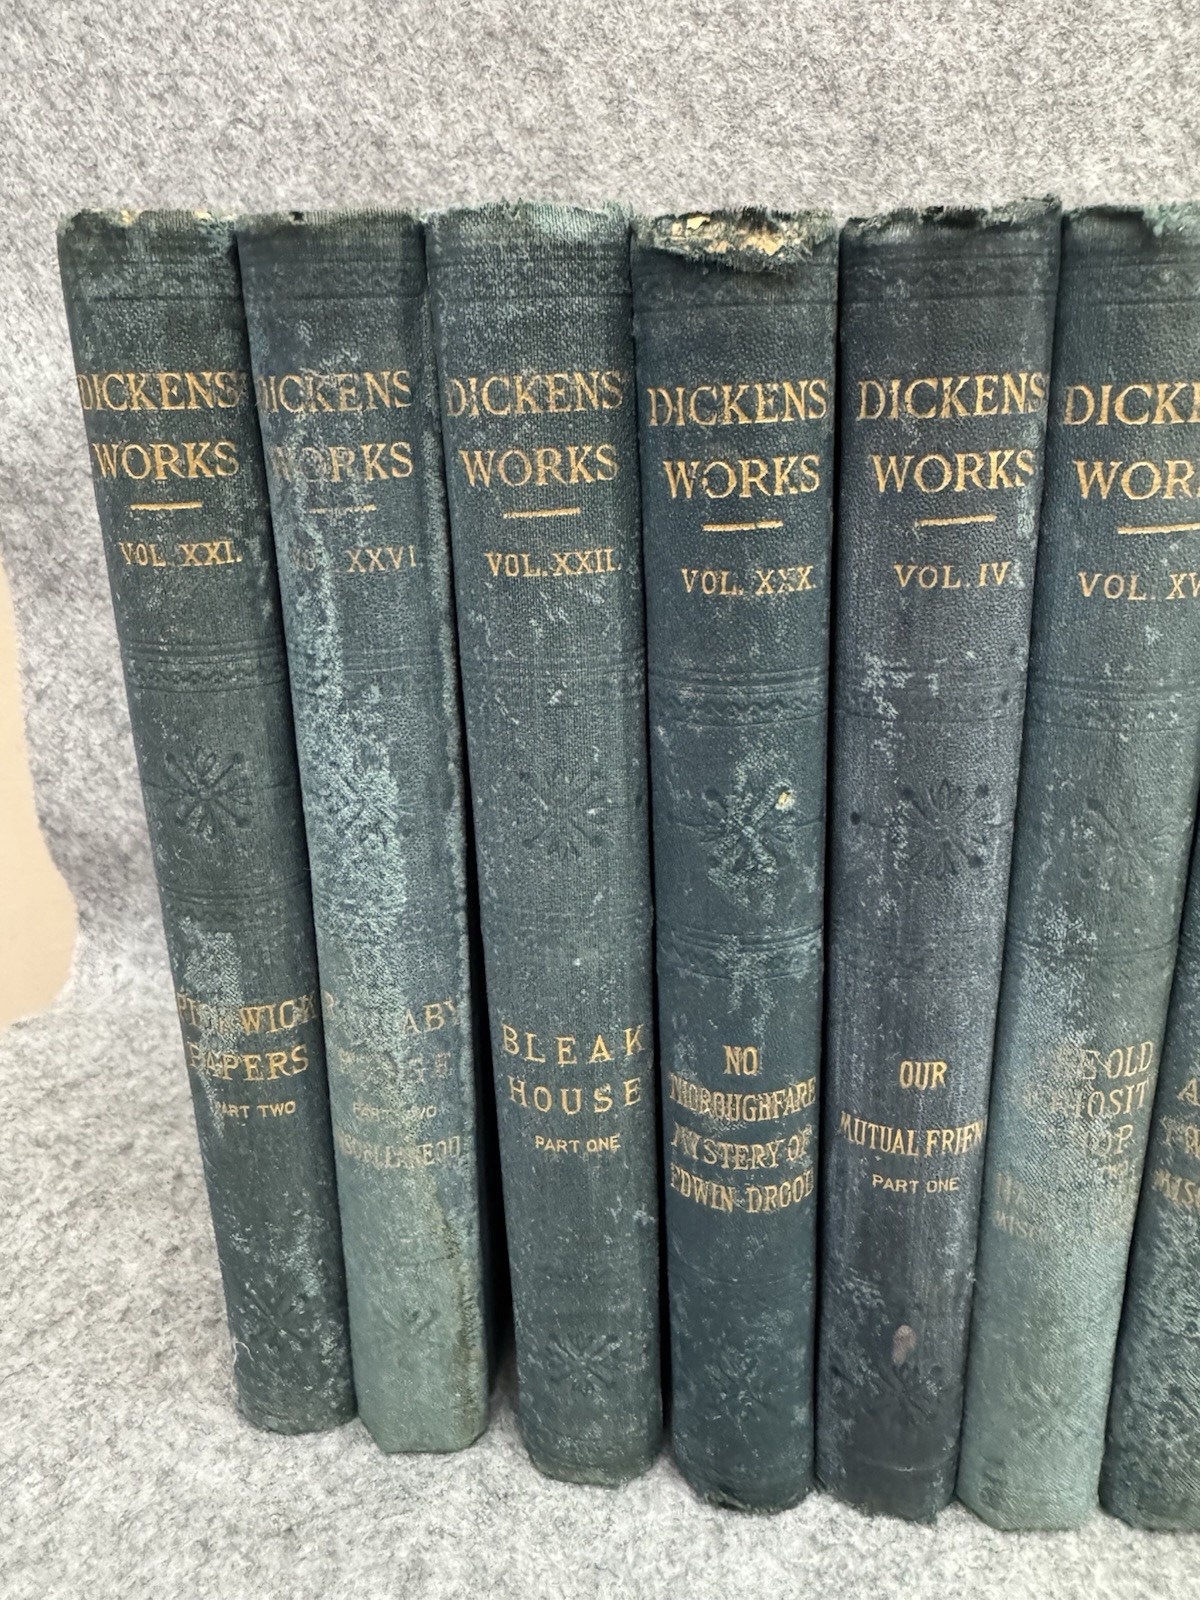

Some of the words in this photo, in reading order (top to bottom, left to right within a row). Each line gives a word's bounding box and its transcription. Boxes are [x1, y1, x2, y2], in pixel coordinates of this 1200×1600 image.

[76, 370, 242, 411] DICKENS
[446, 370, 622, 417] DICKENS
[647, 378, 829, 426] DICKENS
[857, 372, 1047, 420] DICKENS
[93, 441, 239, 480] WORKS
[459, 444, 619, 488] WORKS
[663, 454, 820, 499] WORKS
[872, 450, 1034, 493] WORKS
[1073, 459, 1200, 501] WOR
[345, 545, 416, 572] XXVI
[502, 1024, 644, 1065] BLEAK
[723, 1045, 759, 1076] NO
[1106, 1041, 1154, 1079] OLD
[507, 1076, 642, 1115] HOUSE
[899, 1060, 948, 1091] OUR
[257, 1101, 296, 1118] TWO
[535, 1136, 580, 1153] PART
[586, 1134, 621, 1151] ONE
[839, 1111, 920, 1157] MUTUAL
[872, 1174, 919, 1194] PART
[926, 1177, 960, 1194] ONE
